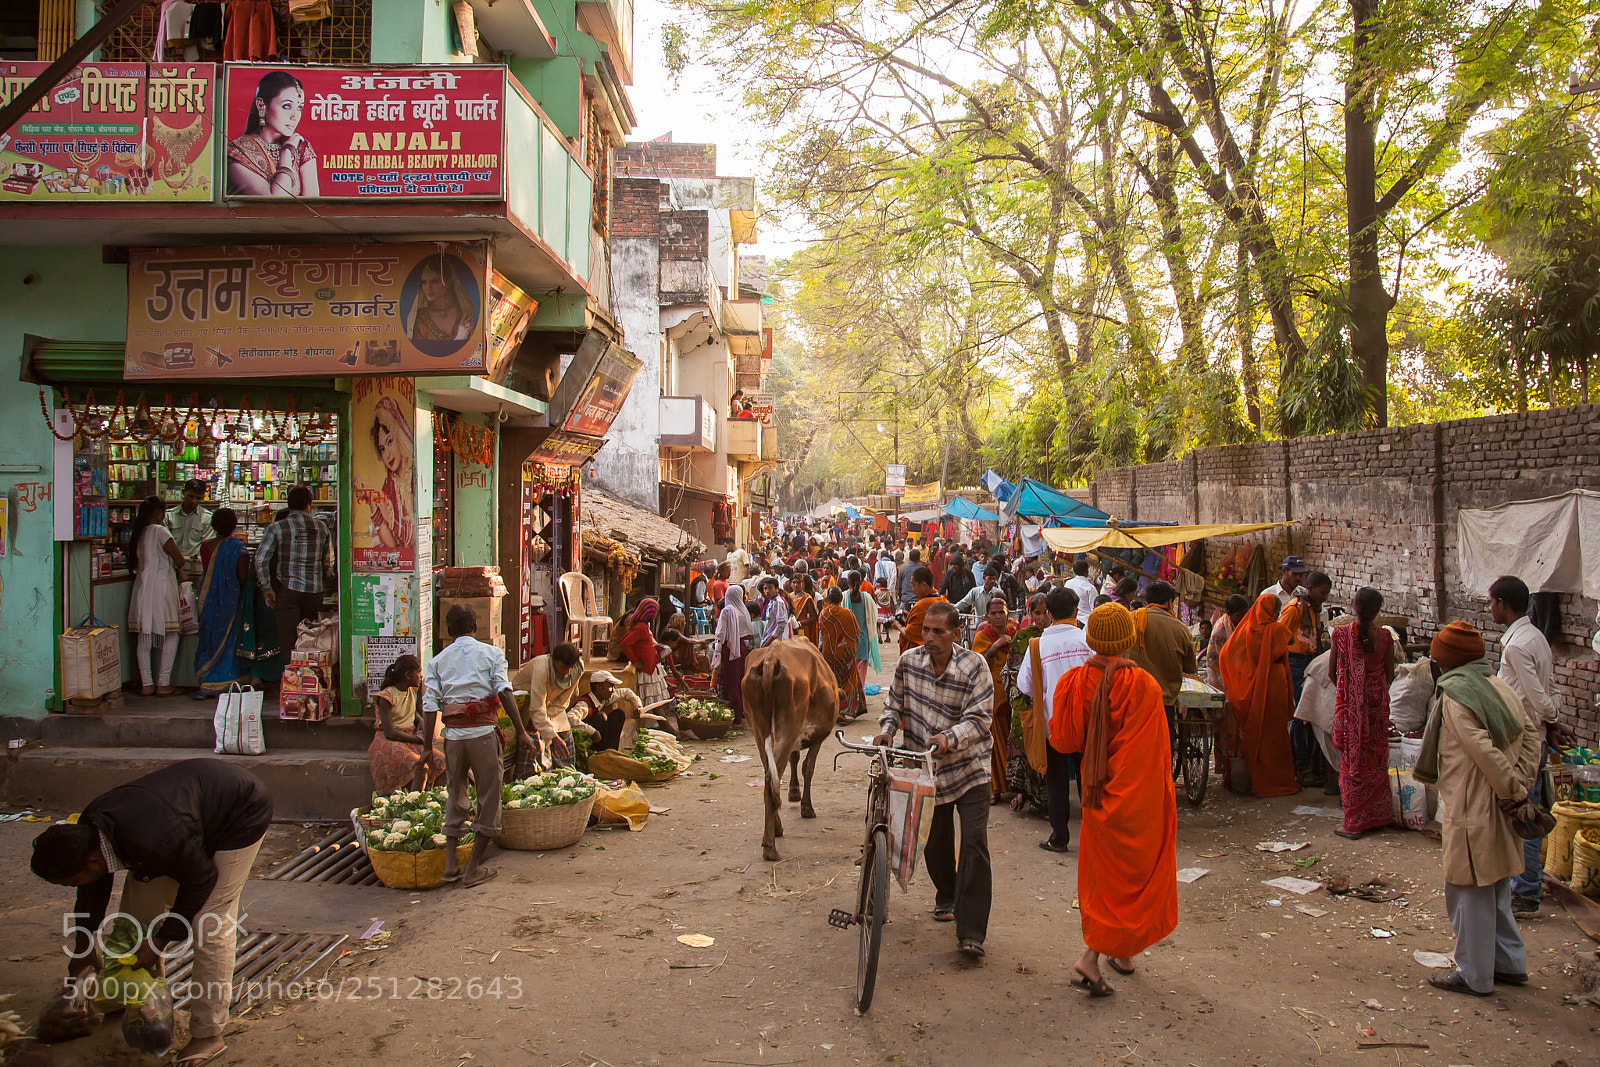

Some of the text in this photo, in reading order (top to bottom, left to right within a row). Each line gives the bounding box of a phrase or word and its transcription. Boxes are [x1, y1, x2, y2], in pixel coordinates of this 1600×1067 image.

[81, 67, 139, 112] गिफ्ट
[148, 68, 208, 113] कॉर्नर
[340, 72, 461, 90] अंजली
[310, 93, 498, 129] लेडिज हर्बल ब्यूटी पार्लर
[100, 140, 109, 153] के
[350, 131, 462, 151] ANJALI
[323, 154, 498, 169] LADIES HARBAL BEAUTY PARLOUR
[332, 173, 364, 182] NOTE
[434, 171, 470, 182] सजायी
[474, 170, 492, 181] एवं
[405, 184, 418, 193] दी
[420, 184, 448, 193] जाती
[145, 256, 255, 323] उत्तम
[251, 293, 398, 320] गिफ्ट कार्नर
[13, 482, 53, 513] शुभ
[356, 489, 386, 505] लाभ
